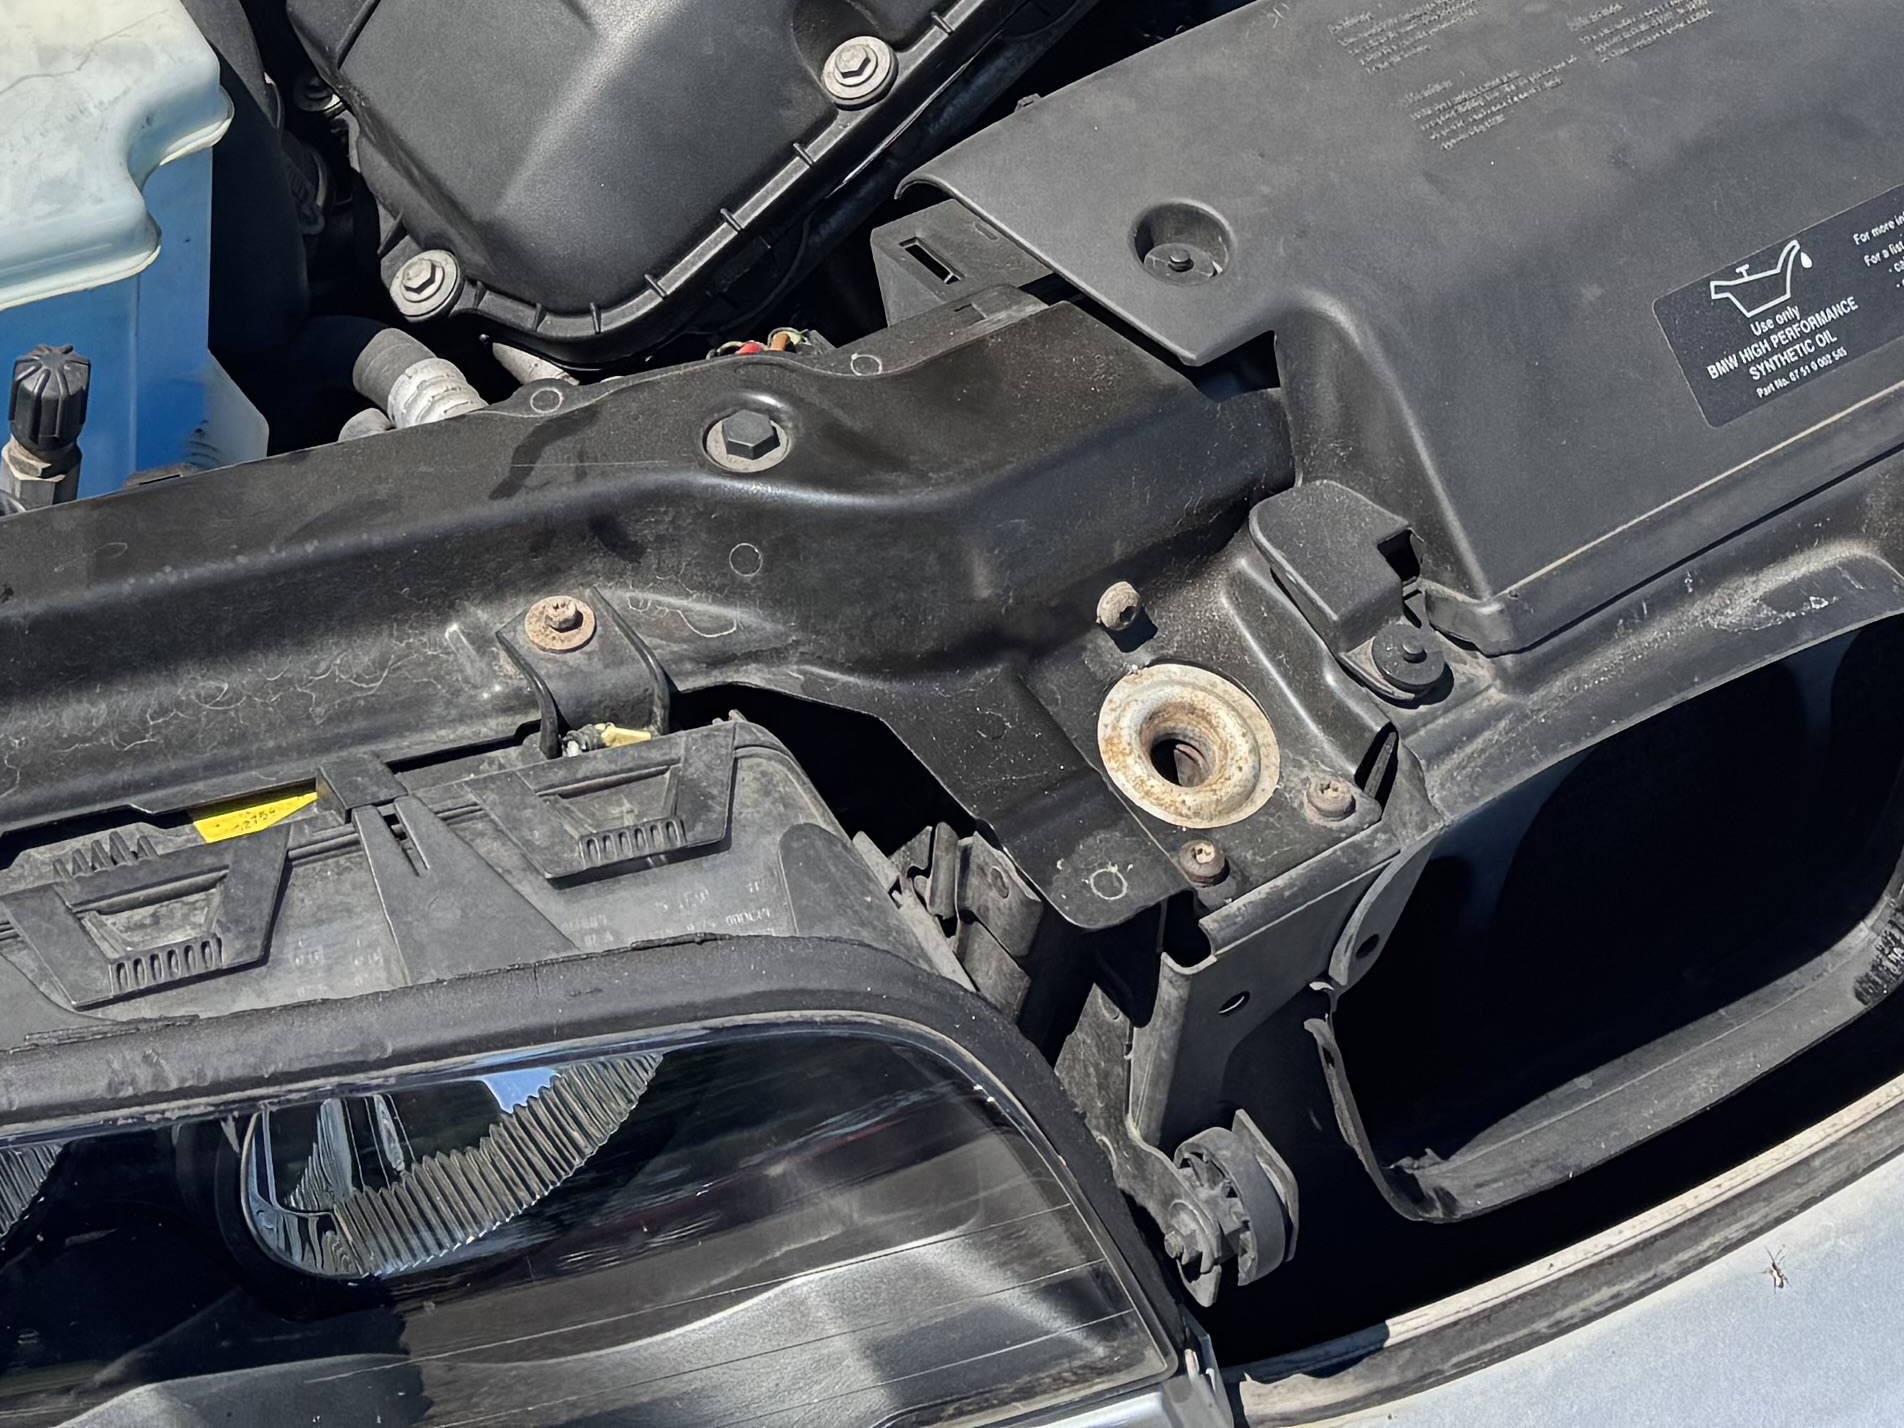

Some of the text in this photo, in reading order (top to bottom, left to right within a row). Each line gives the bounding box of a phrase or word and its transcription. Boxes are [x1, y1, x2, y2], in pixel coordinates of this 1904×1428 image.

[1853, 233, 1870, 245] For
[1871, 222, 1895, 238] more
[1863, 252, 1881, 267] For
[1881, 249, 1889, 259] a
[1888, 240, 1904, 256] list
[1750, 305, 1801, 336] Use only
[1707, 296, 1859, 379] BMW HIGH PERFORMANCE
[1749, 330, 1838, 381] SYNTHETIC OIL
[1756, 382, 1776, 399] Part
[1774, 378, 1790, 390] No.
